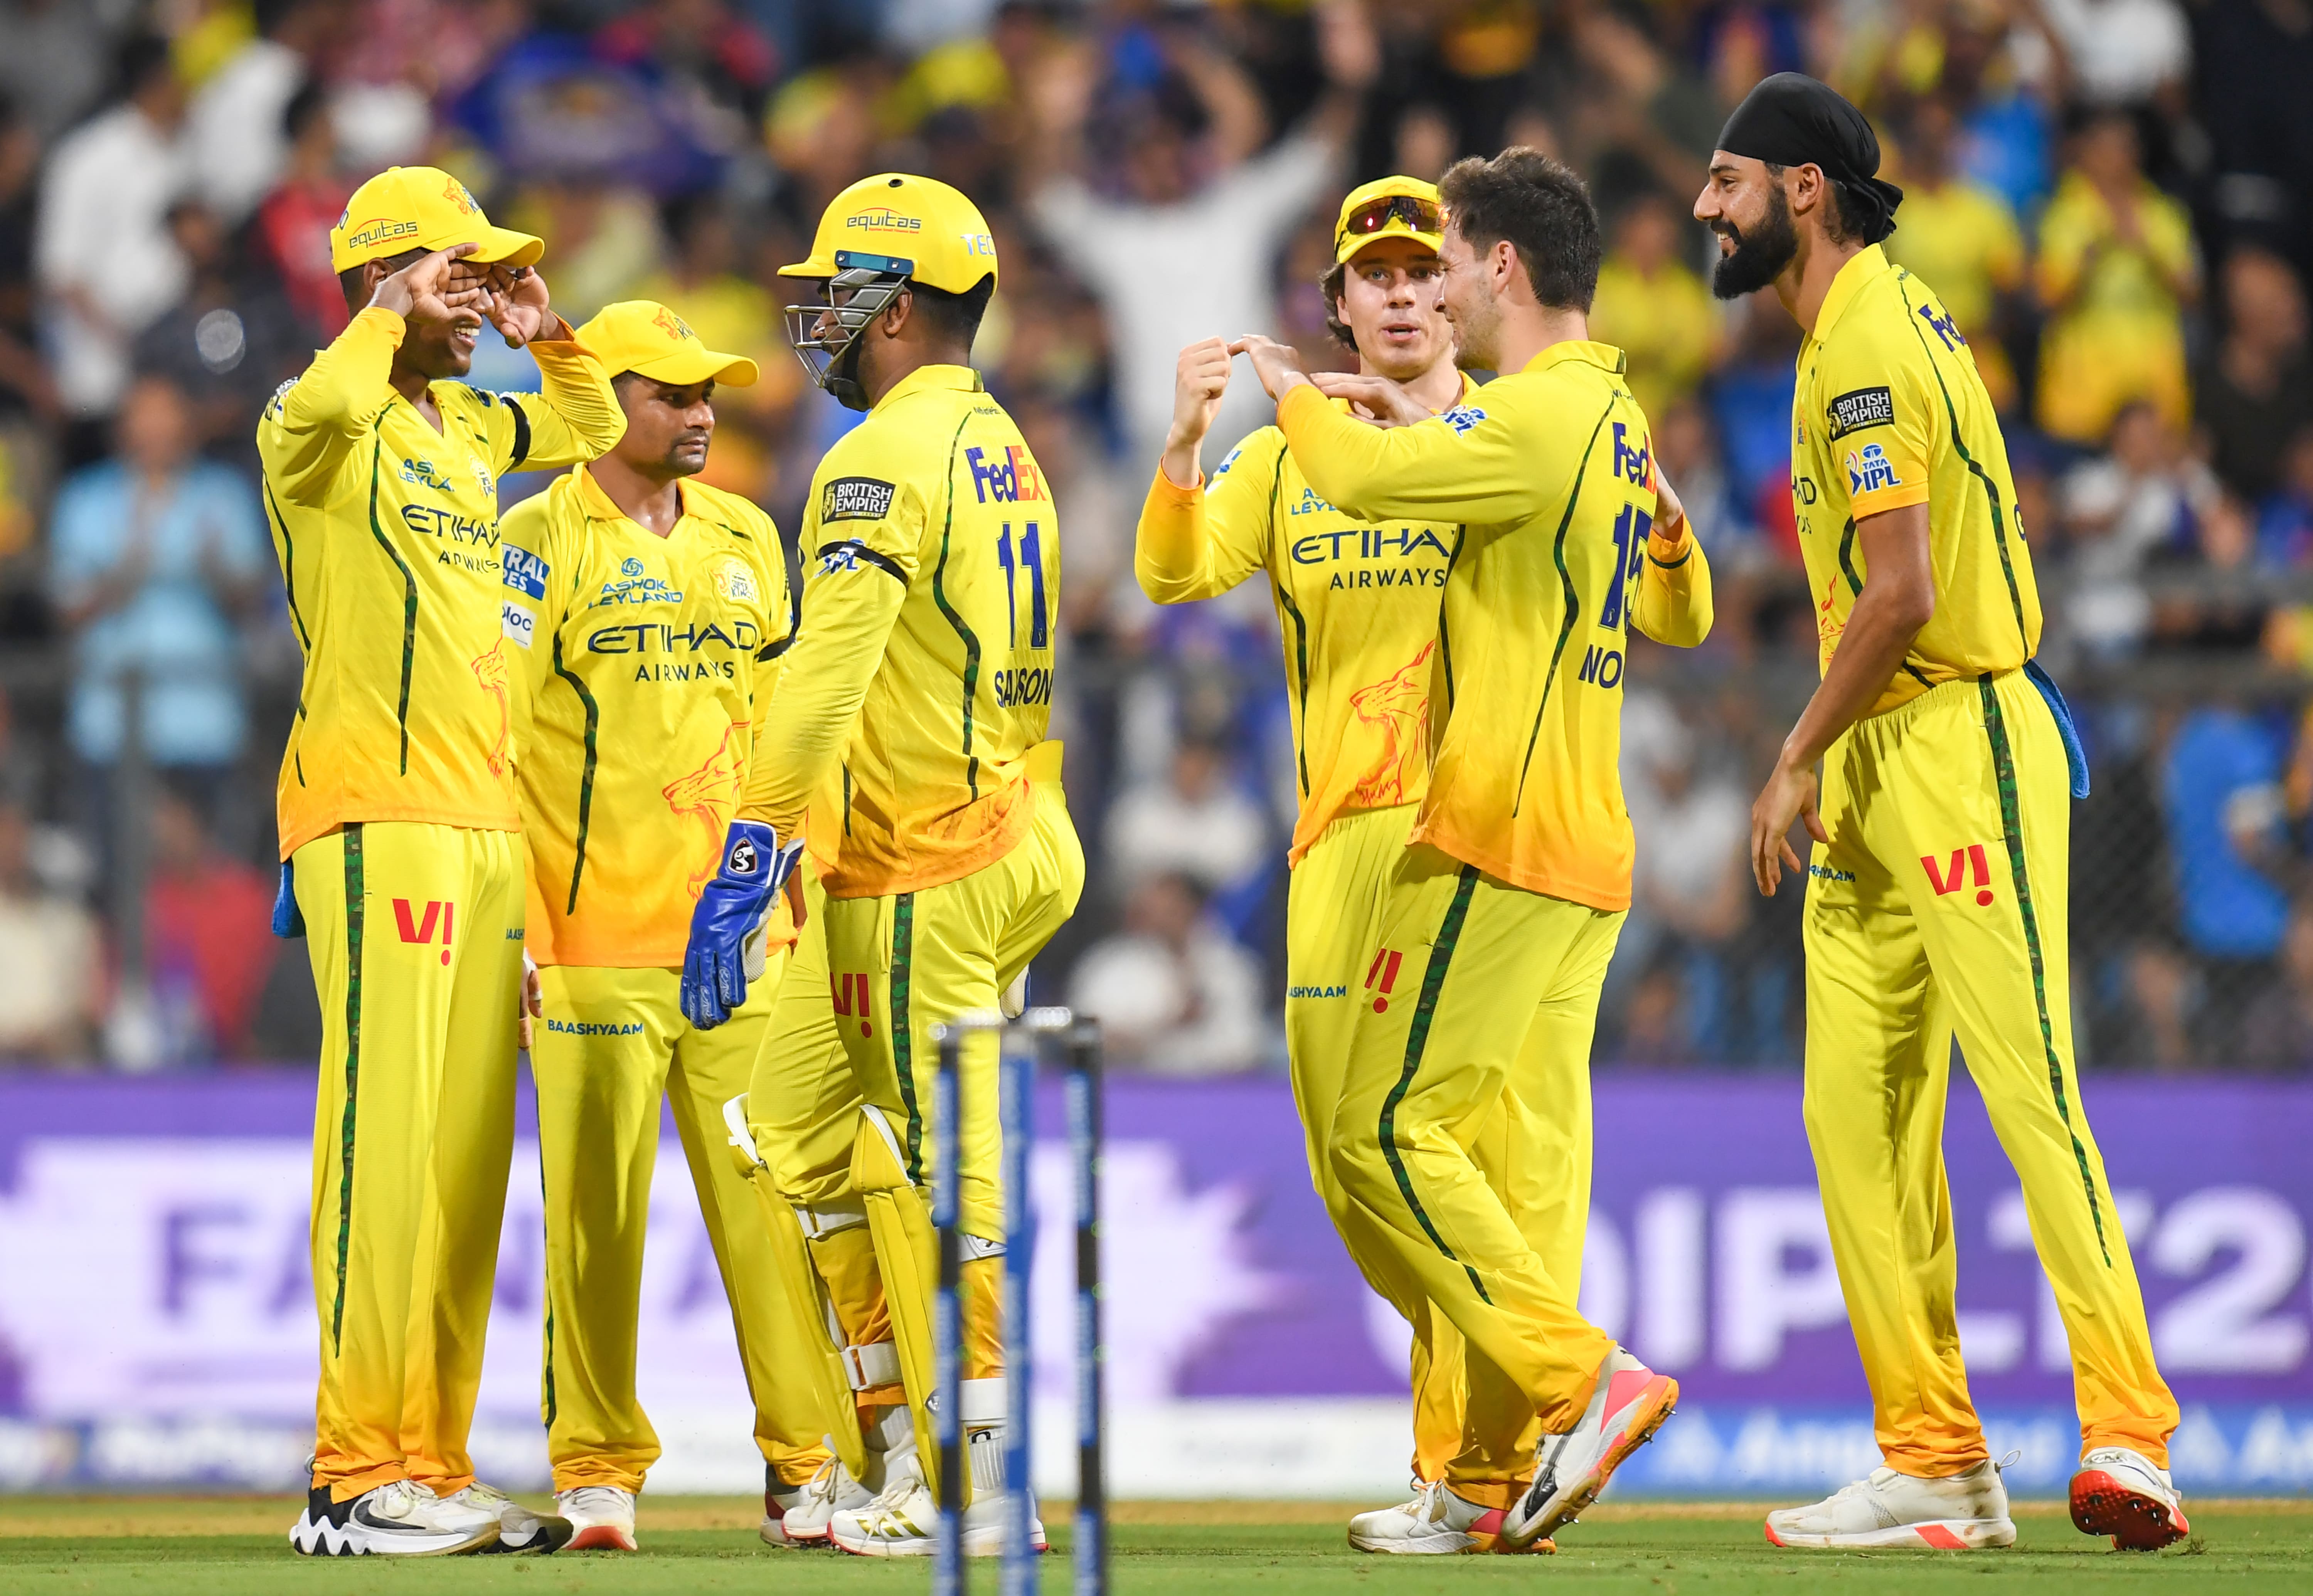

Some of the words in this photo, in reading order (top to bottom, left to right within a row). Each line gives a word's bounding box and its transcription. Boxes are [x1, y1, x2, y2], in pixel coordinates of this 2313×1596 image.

[847, 211, 921, 232] equitas
[349, 221, 417, 248] equitas
[1837, 392, 1889, 415] BRITISH
[1840, 405, 1892, 427] EMPIRE
[1612, 422, 1657, 495] FedE
[1863, 458, 1887, 469] TATA
[965, 446, 1047, 503] FedEx
[1863, 465, 1901, 491] IPL
[837, 483, 892, 500] BRITISH
[835, 497, 889, 513] EMPIRE
[1292, 528, 1455, 564] ETIHA
[601, 579, 668, 594] ASHOK
[997, 521, 1047, 650] 11
[1330, 568, 1446, 590] AIRWAYS
[588, 591, 684, 609] LEYLAND
[588, 621, 757, 653] ETIHAD
[635, 661, 734, 682] AIRWAYS
[1578, 644, 1623, 689] NO
[547, 1019, 643, 1036] BAASHYAAM
